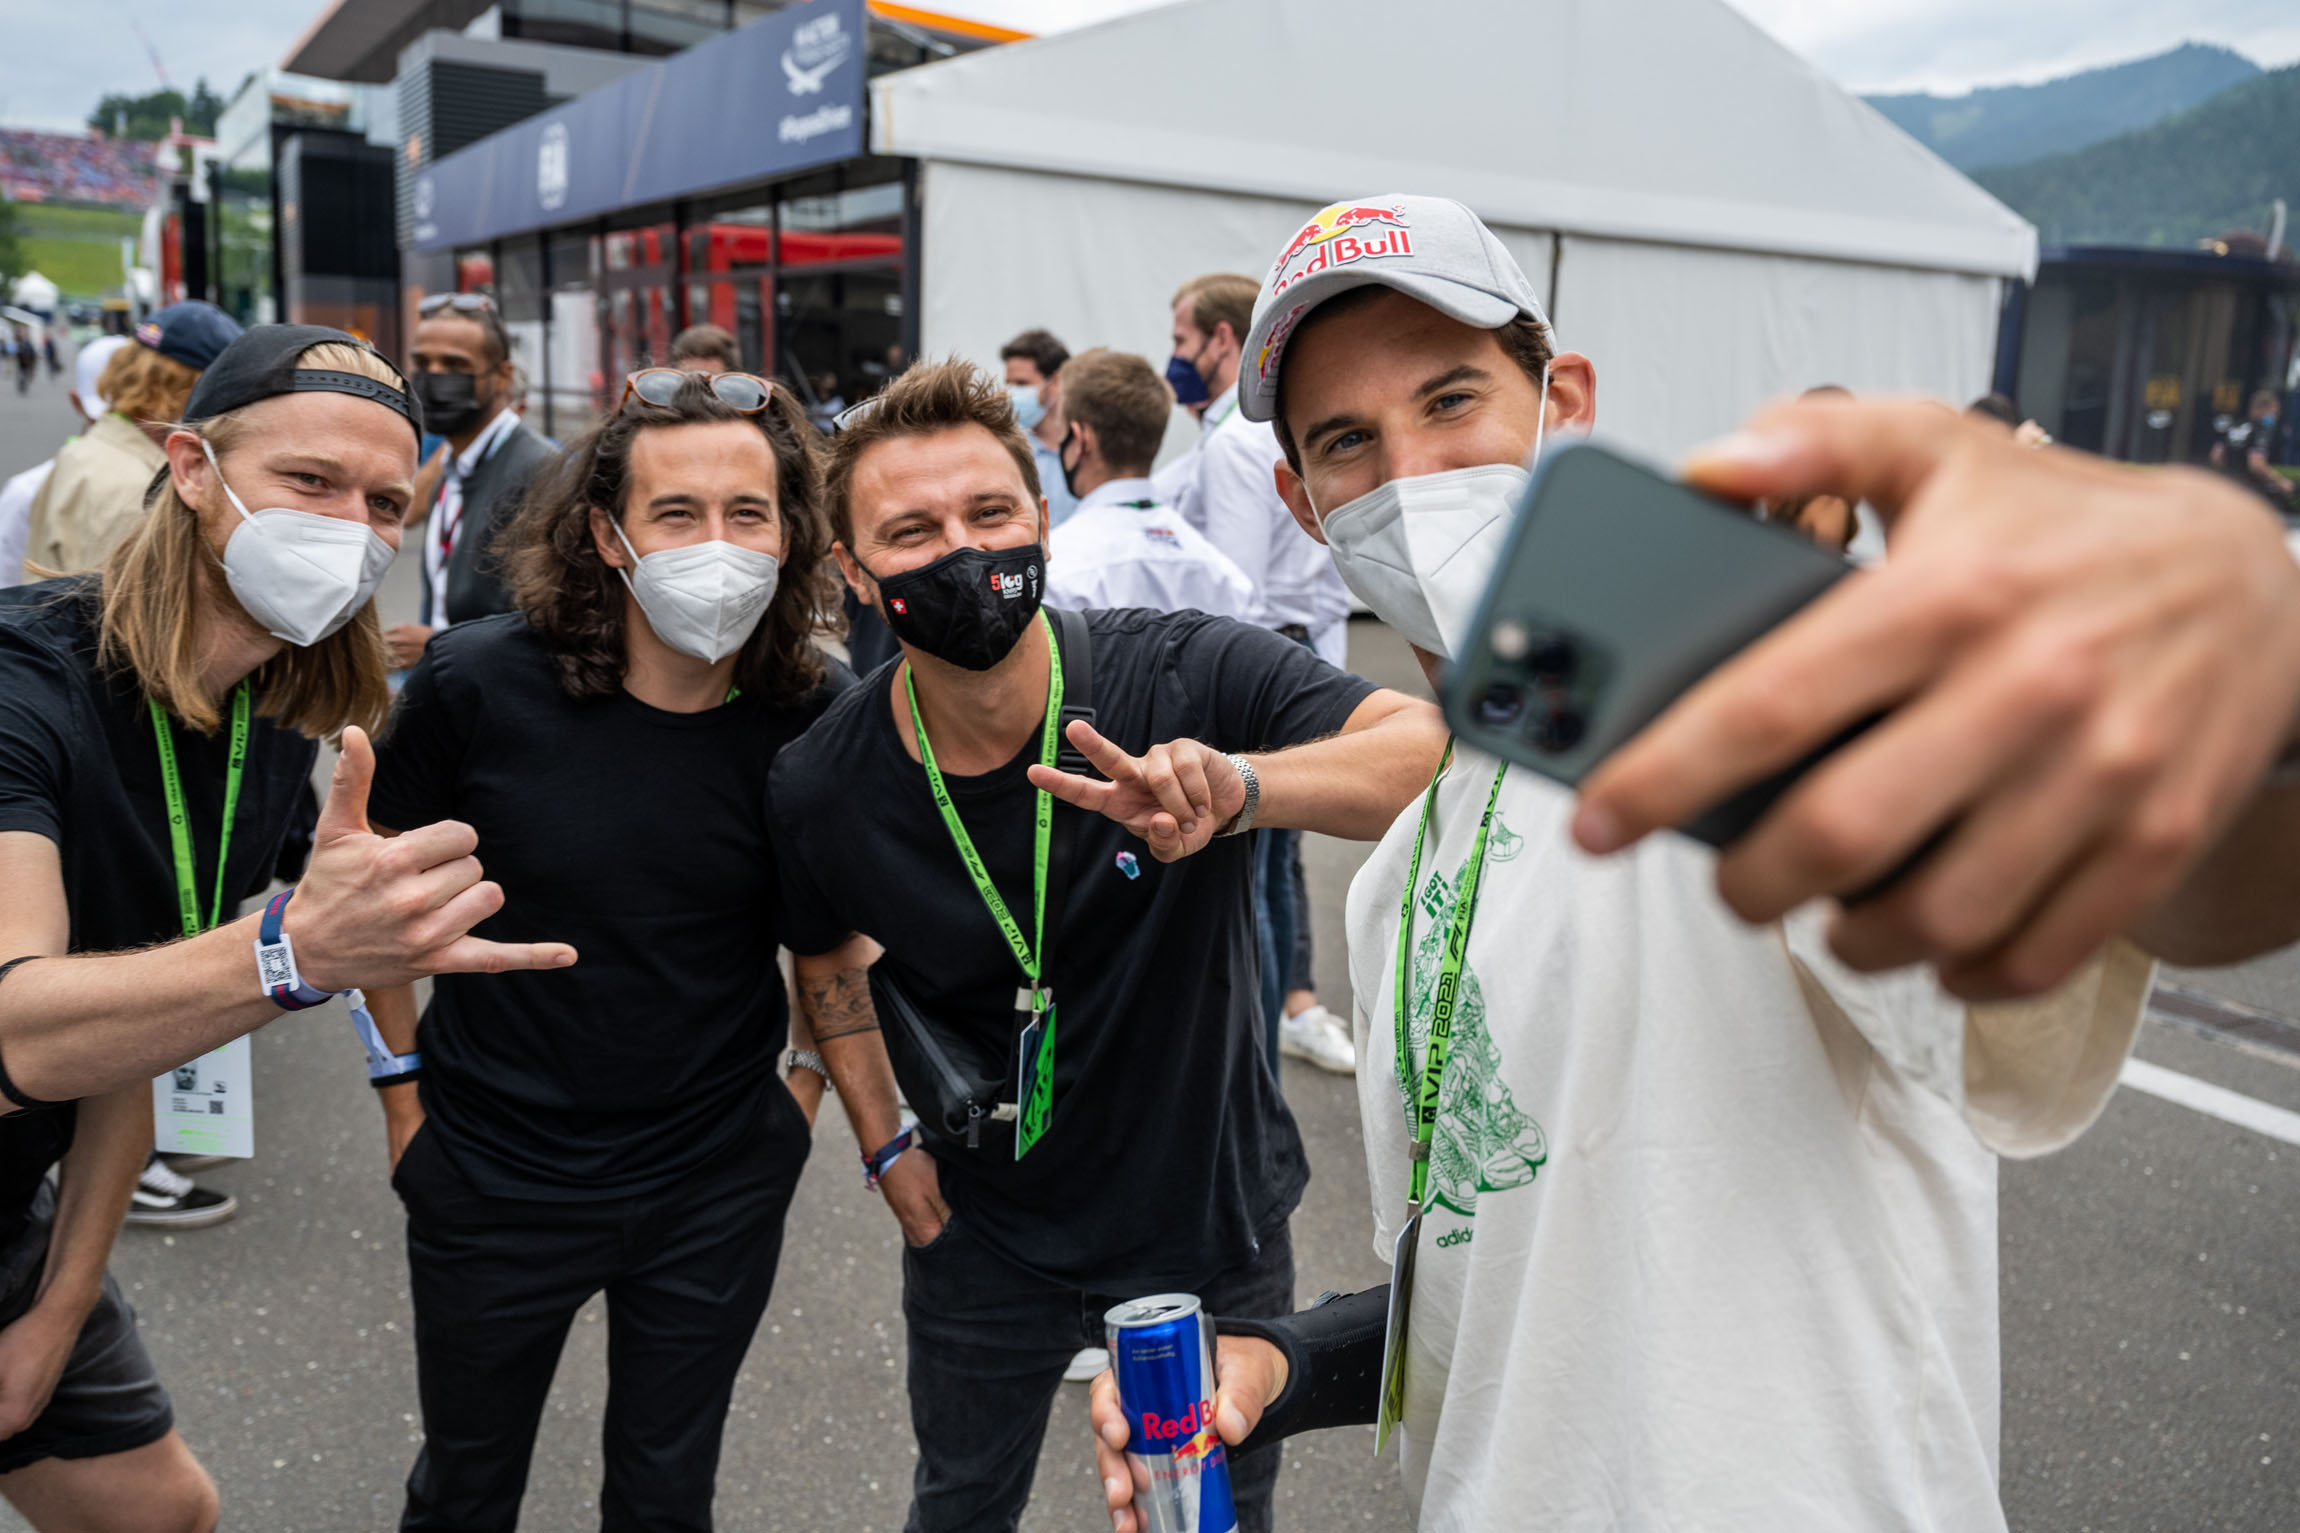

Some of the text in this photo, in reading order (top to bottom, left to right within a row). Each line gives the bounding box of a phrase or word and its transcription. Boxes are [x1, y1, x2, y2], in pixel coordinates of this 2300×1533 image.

[1334, 230, 1411, 263] Bull
[982, 883, 1010, 921] 2021
[1424, 870, 1442, 899] GOT
[1003, 922, 1025, 954] VIP
[1431, 971, 1457, 1039] 2021
[1425, 1043, 1442, 1102] VIP
[1436, 1226, 1473, 1248] adid
[1142, 1403, 1197, 1440] Red
